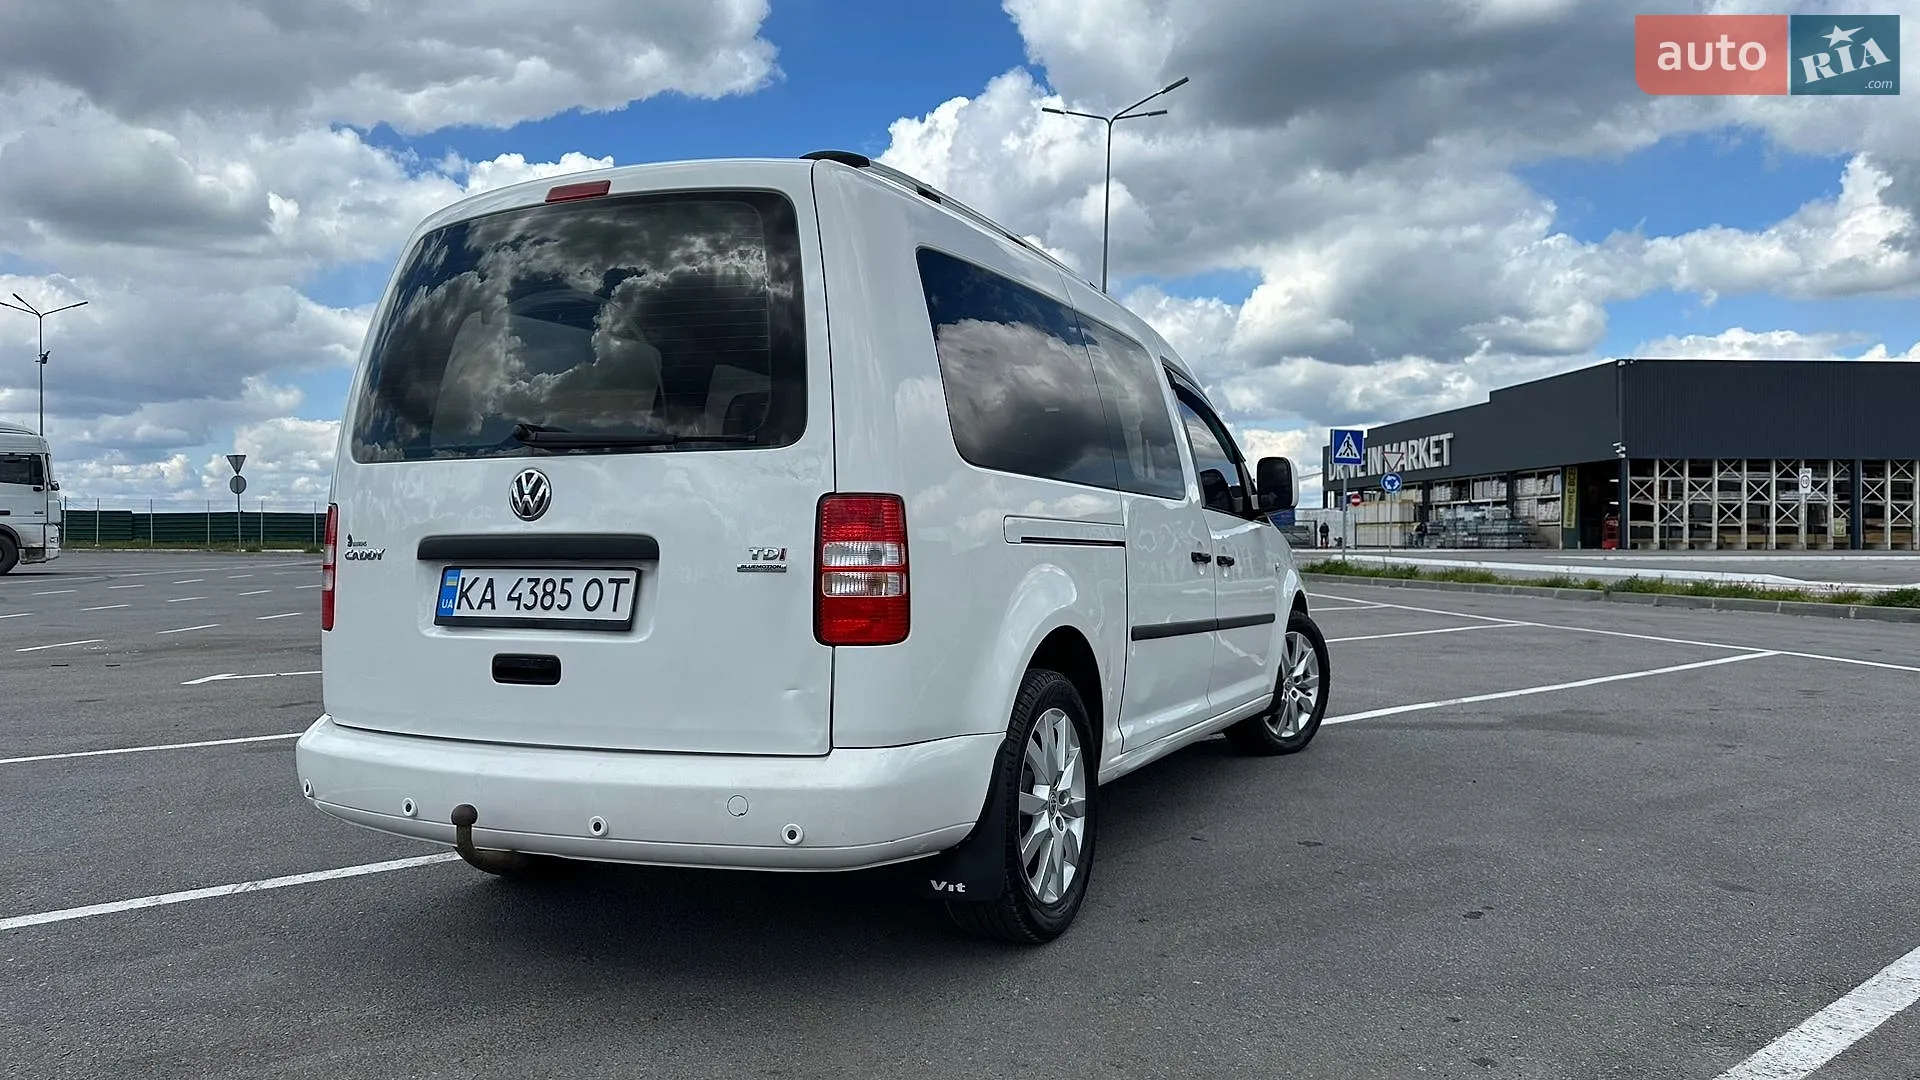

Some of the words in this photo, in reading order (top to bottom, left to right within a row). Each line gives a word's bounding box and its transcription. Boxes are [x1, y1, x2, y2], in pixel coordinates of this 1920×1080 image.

[1367, 445, 1383, 476] IN
[344, 548, 386, 560] CADDY
[748, 546, 787, 561] TDI
[455, 576, 497, 611] KA
[506, 577, 574, 611] 4385
[582, 577, 631, 613] OT
[441, 598, 454, 609] UA
